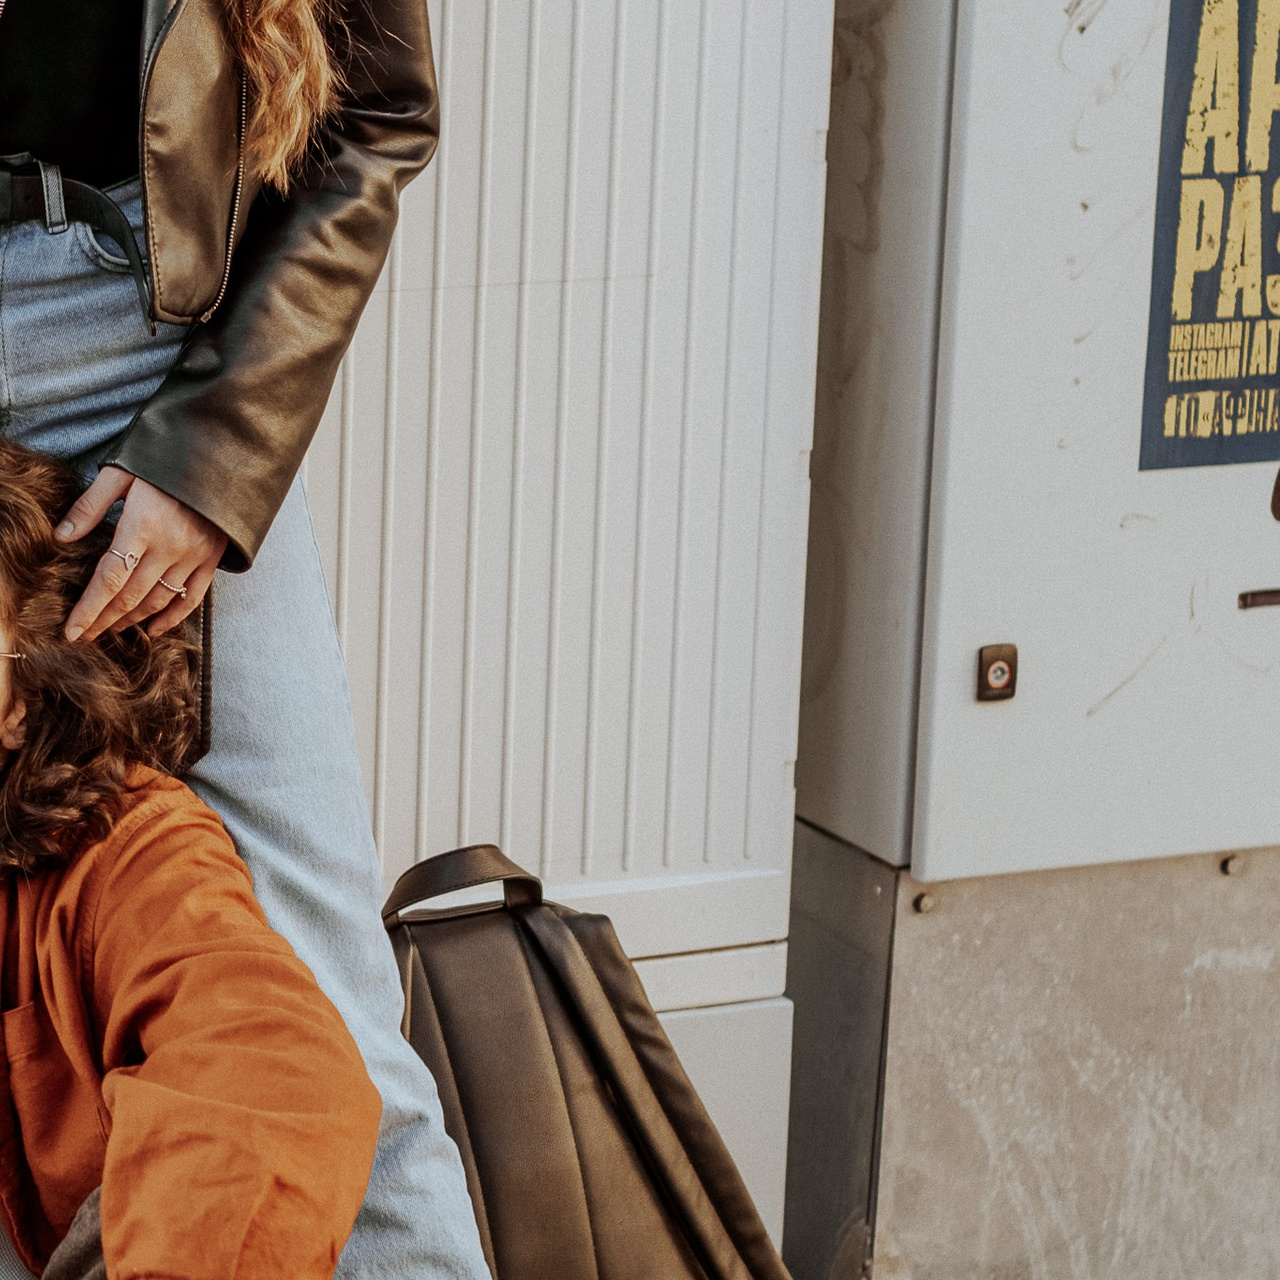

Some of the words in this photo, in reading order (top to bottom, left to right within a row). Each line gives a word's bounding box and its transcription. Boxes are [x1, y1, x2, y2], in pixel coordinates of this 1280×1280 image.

[1172, 174, 1280, 321] РА
[1170, 321, 1242, 350] INSTAGRAM
[1168, 348, 1240, 382] TELEGRAM
